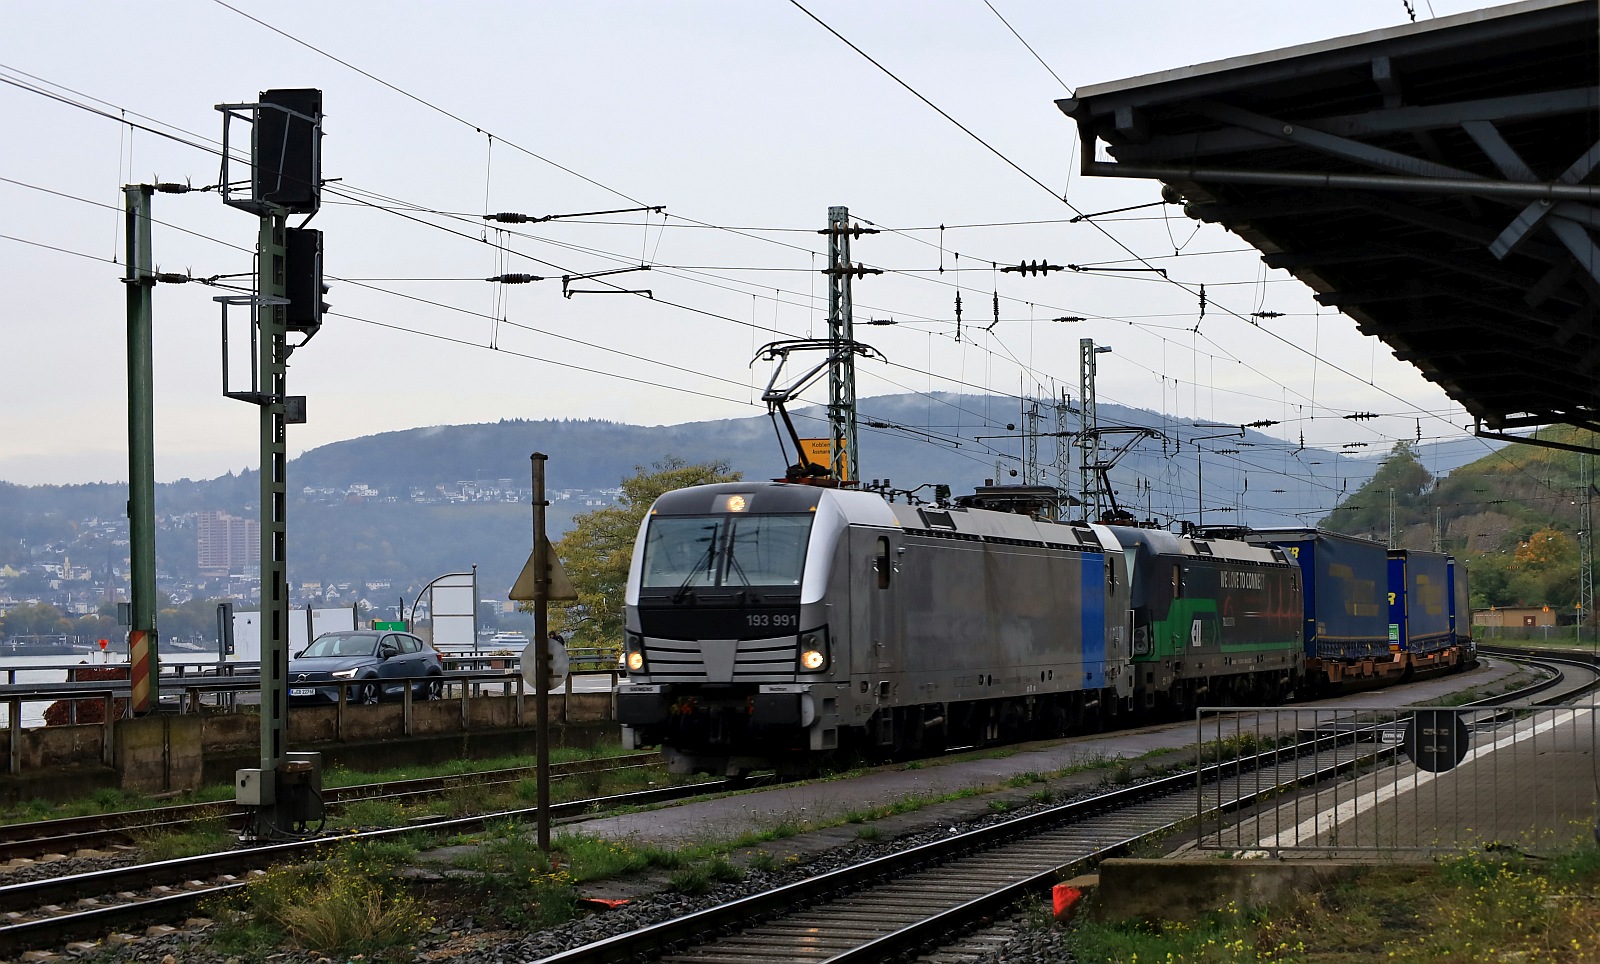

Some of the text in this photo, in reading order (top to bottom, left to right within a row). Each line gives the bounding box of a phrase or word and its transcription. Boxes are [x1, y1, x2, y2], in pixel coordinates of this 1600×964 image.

[1220, 570, 1228, 588] WE
[1228, 571, 1240, 589] LOVE
[1240, 572, 1246, 589] TO
[746, 614, 796, 626] 193 991
